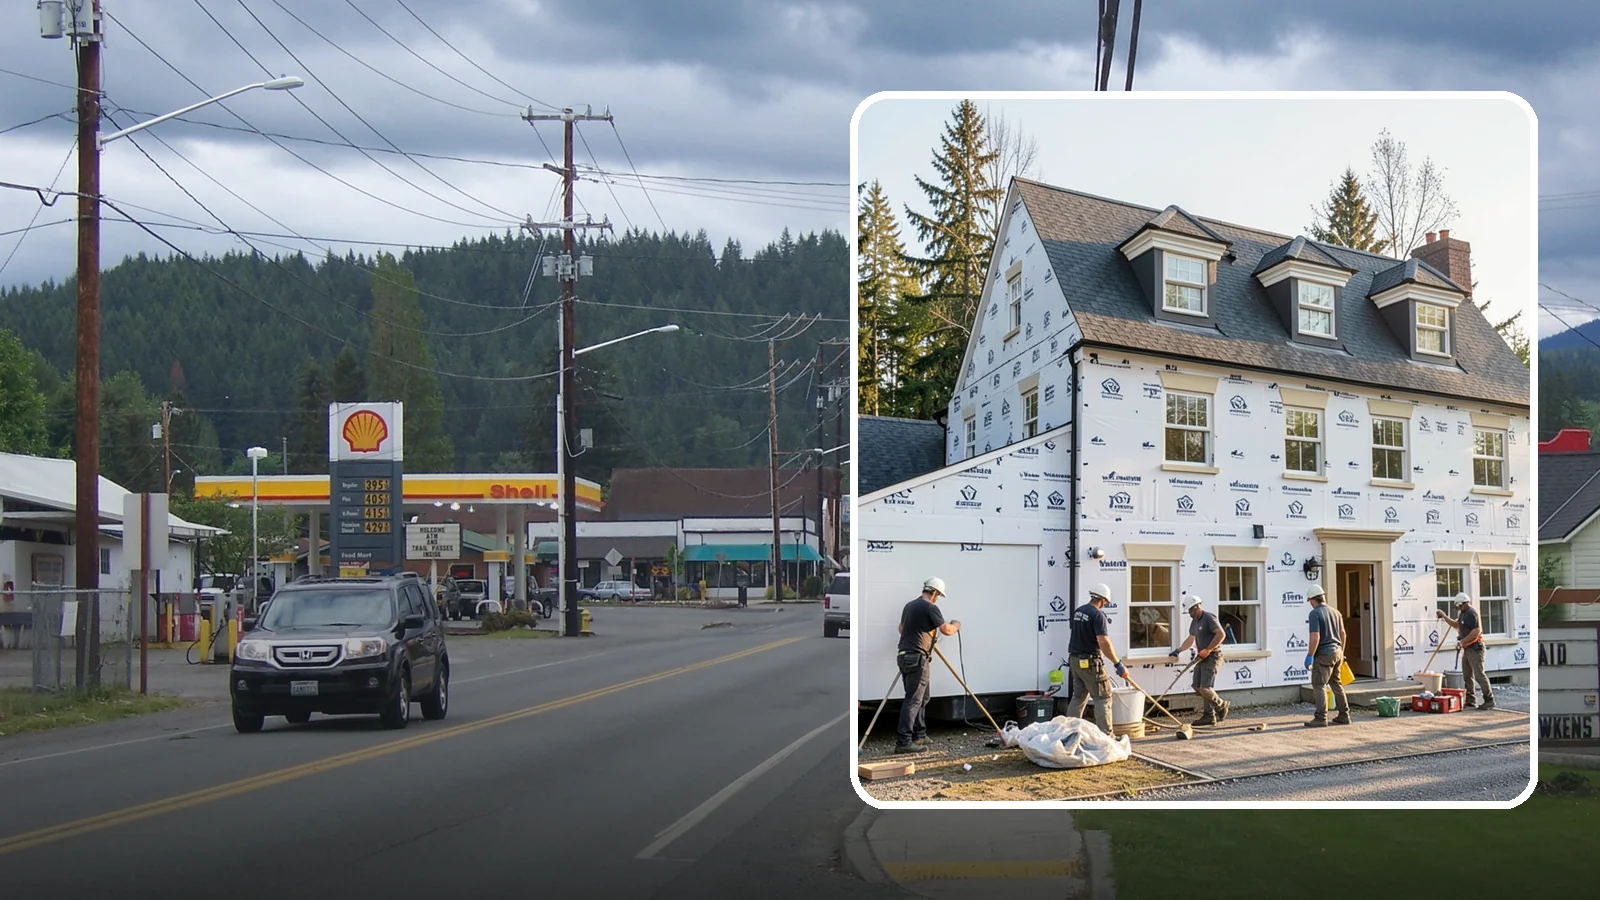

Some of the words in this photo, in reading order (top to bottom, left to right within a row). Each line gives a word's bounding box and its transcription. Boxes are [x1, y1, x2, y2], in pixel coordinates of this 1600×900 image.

[366, 480, 383, 490] 395
[490, 484, 547, 499] Shell
[366, 494, 383, 504] 405
[366, 508, 383, 518] 415
[366, 522, 383, 532] 429
